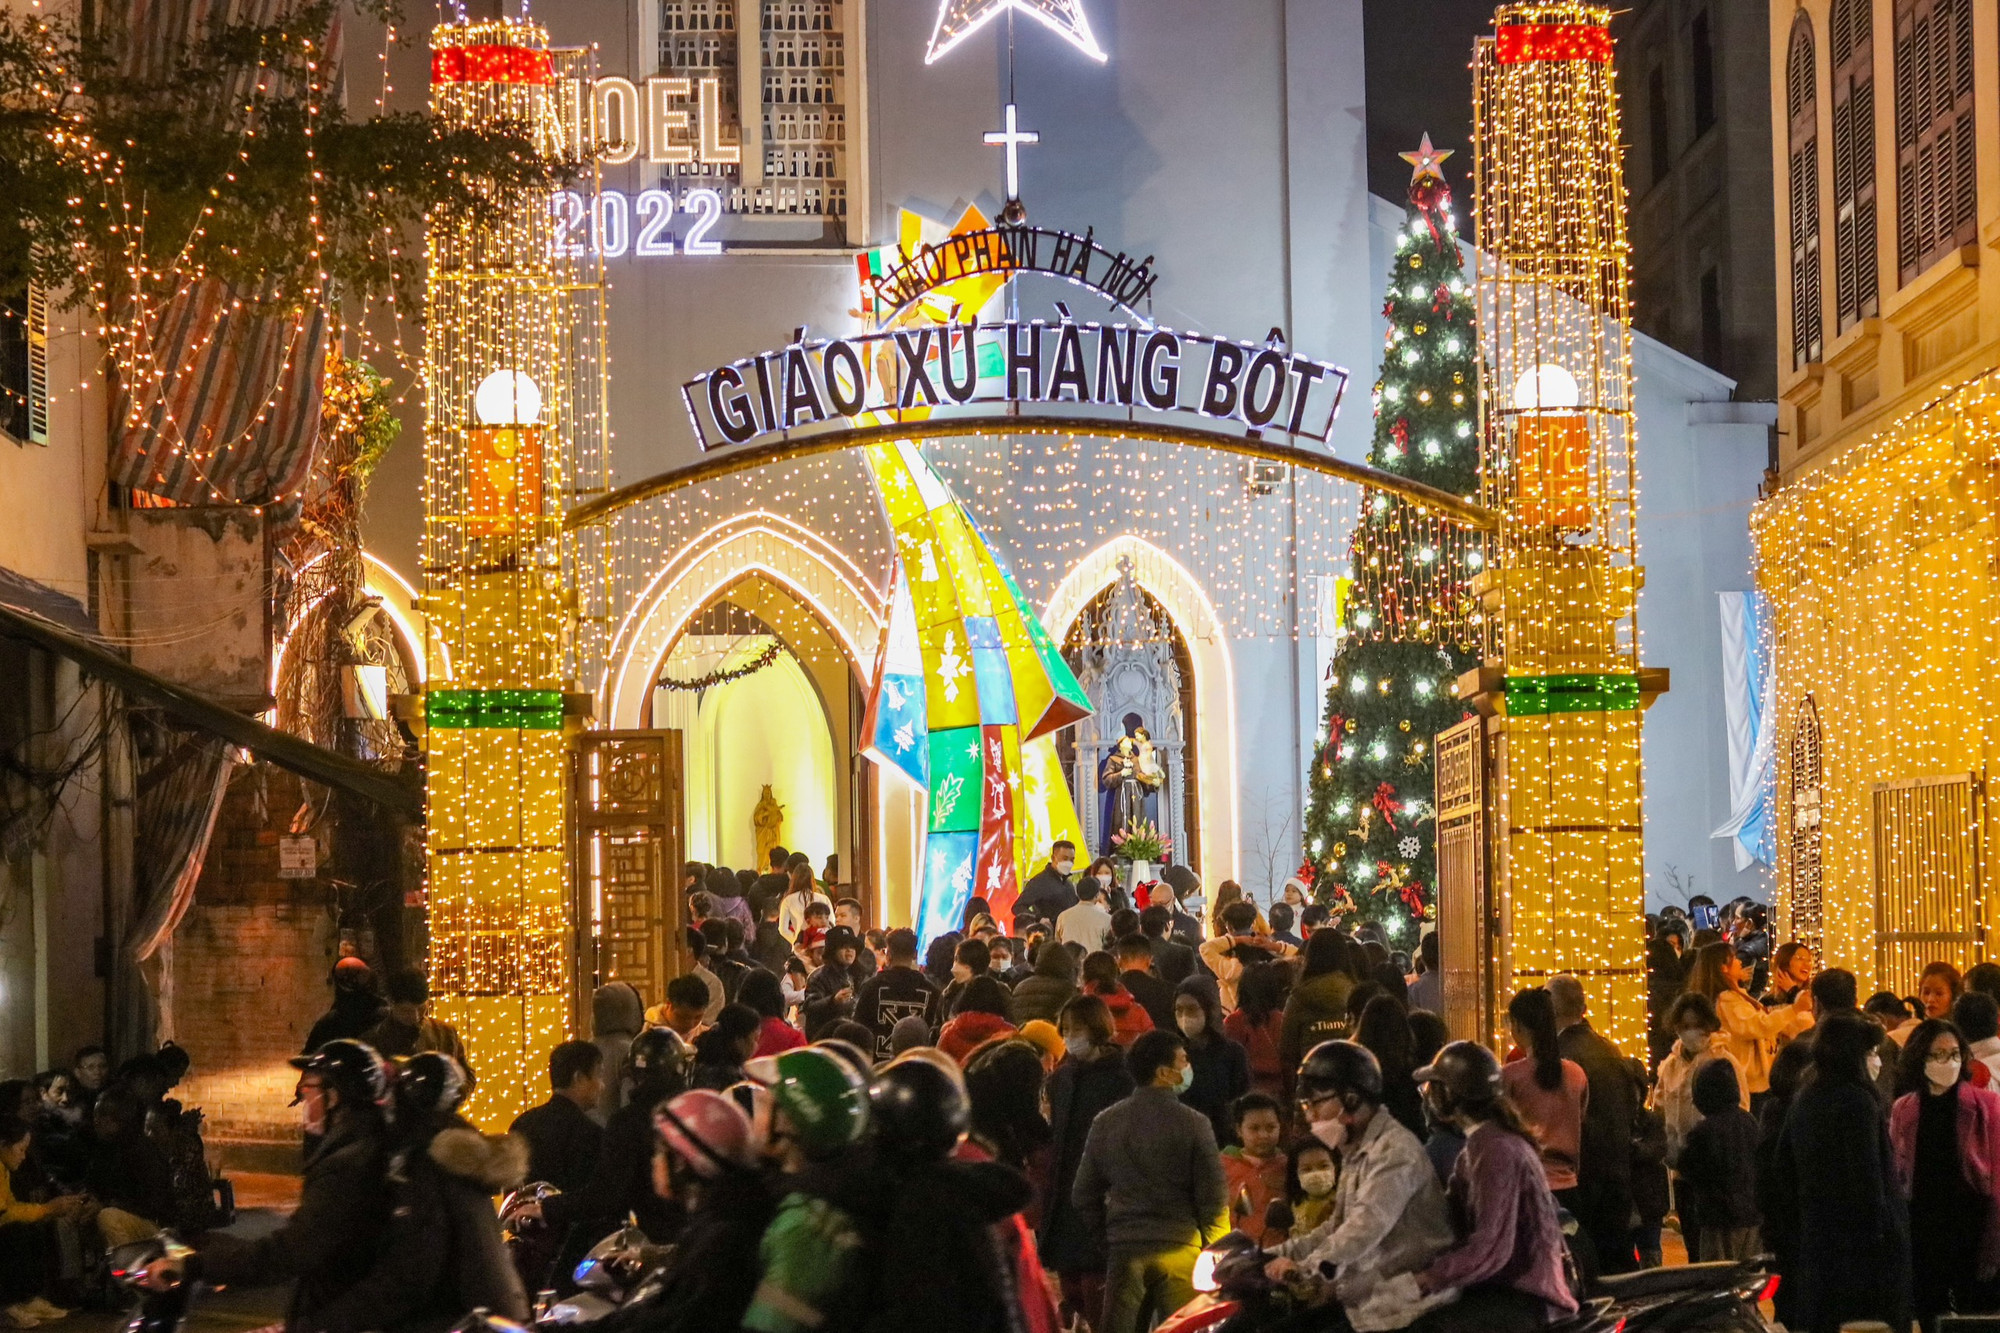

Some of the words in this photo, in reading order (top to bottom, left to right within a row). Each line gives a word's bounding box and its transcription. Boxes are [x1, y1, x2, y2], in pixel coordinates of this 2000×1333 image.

[527, 75, 740, 164] NOEL
[547, 188, 722, 258] 2022
[1050, 225, 1093, 283] HÀ
[706, 326, 866, 444] GIÁO
[893, 303, 979, 409] XỨ
[1004, 300, 1181, 411] HÀNG
[1199, 326, 1327, 440] BỘT
